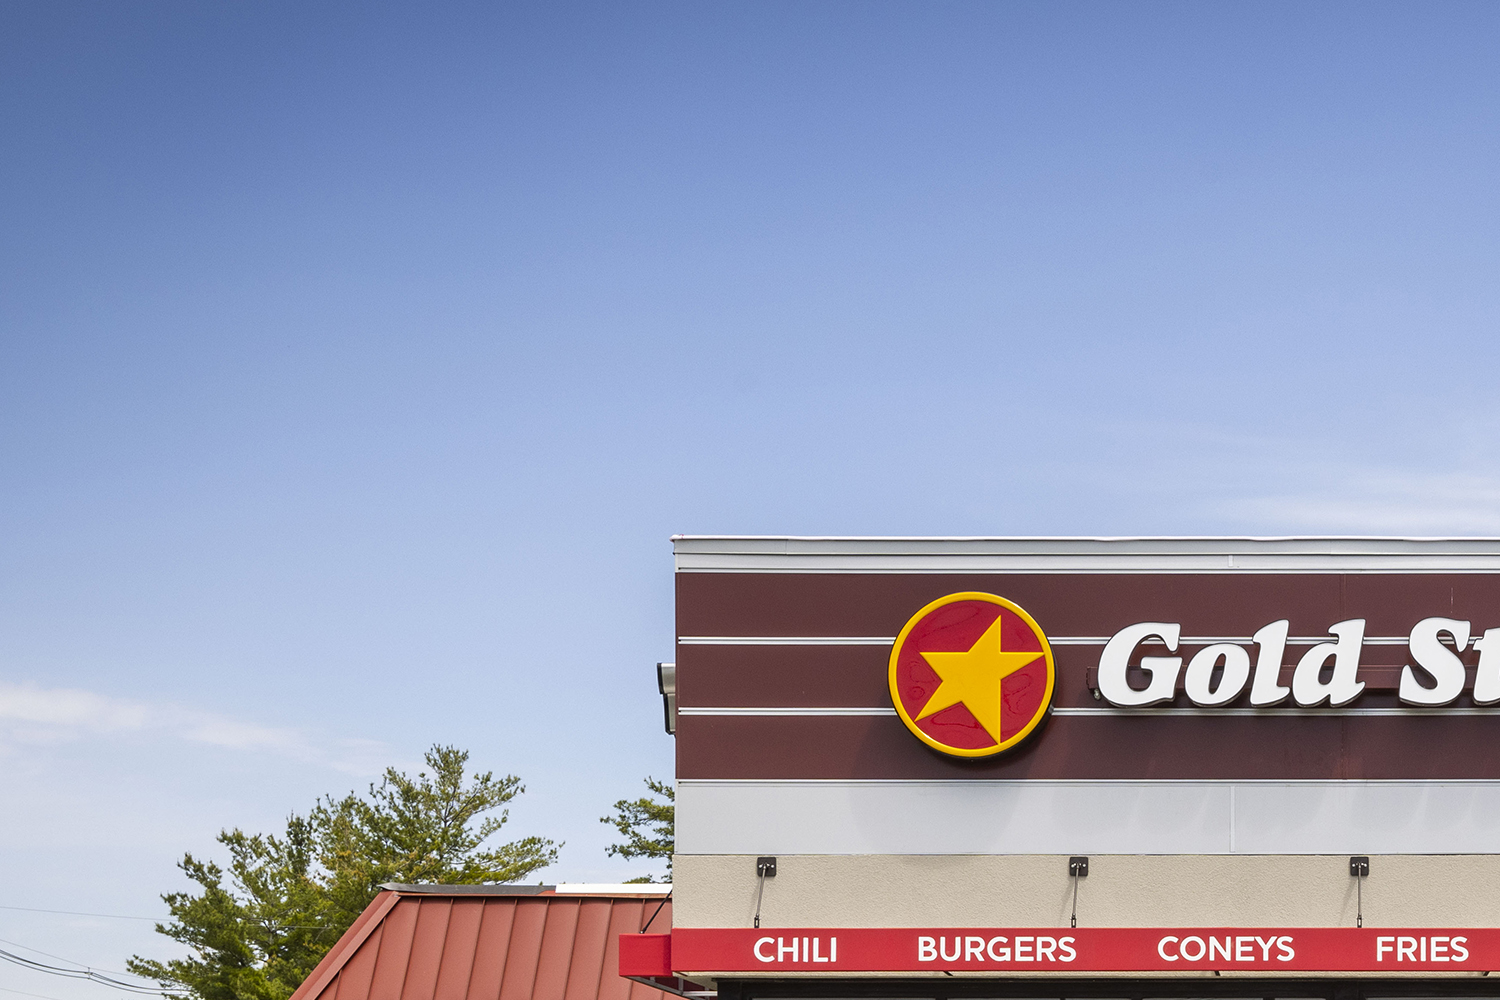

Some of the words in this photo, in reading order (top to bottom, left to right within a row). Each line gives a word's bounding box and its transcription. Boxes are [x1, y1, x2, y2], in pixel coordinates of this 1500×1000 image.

[1097, 618, 1367, 706] Gold
[753, 936, 838, 963] CHILI
[917, 936, 1078, 963] BURGERS
[1156, 935, 1296, 962] CONEYS
[1375, 936, 1470, 962] FRIES
